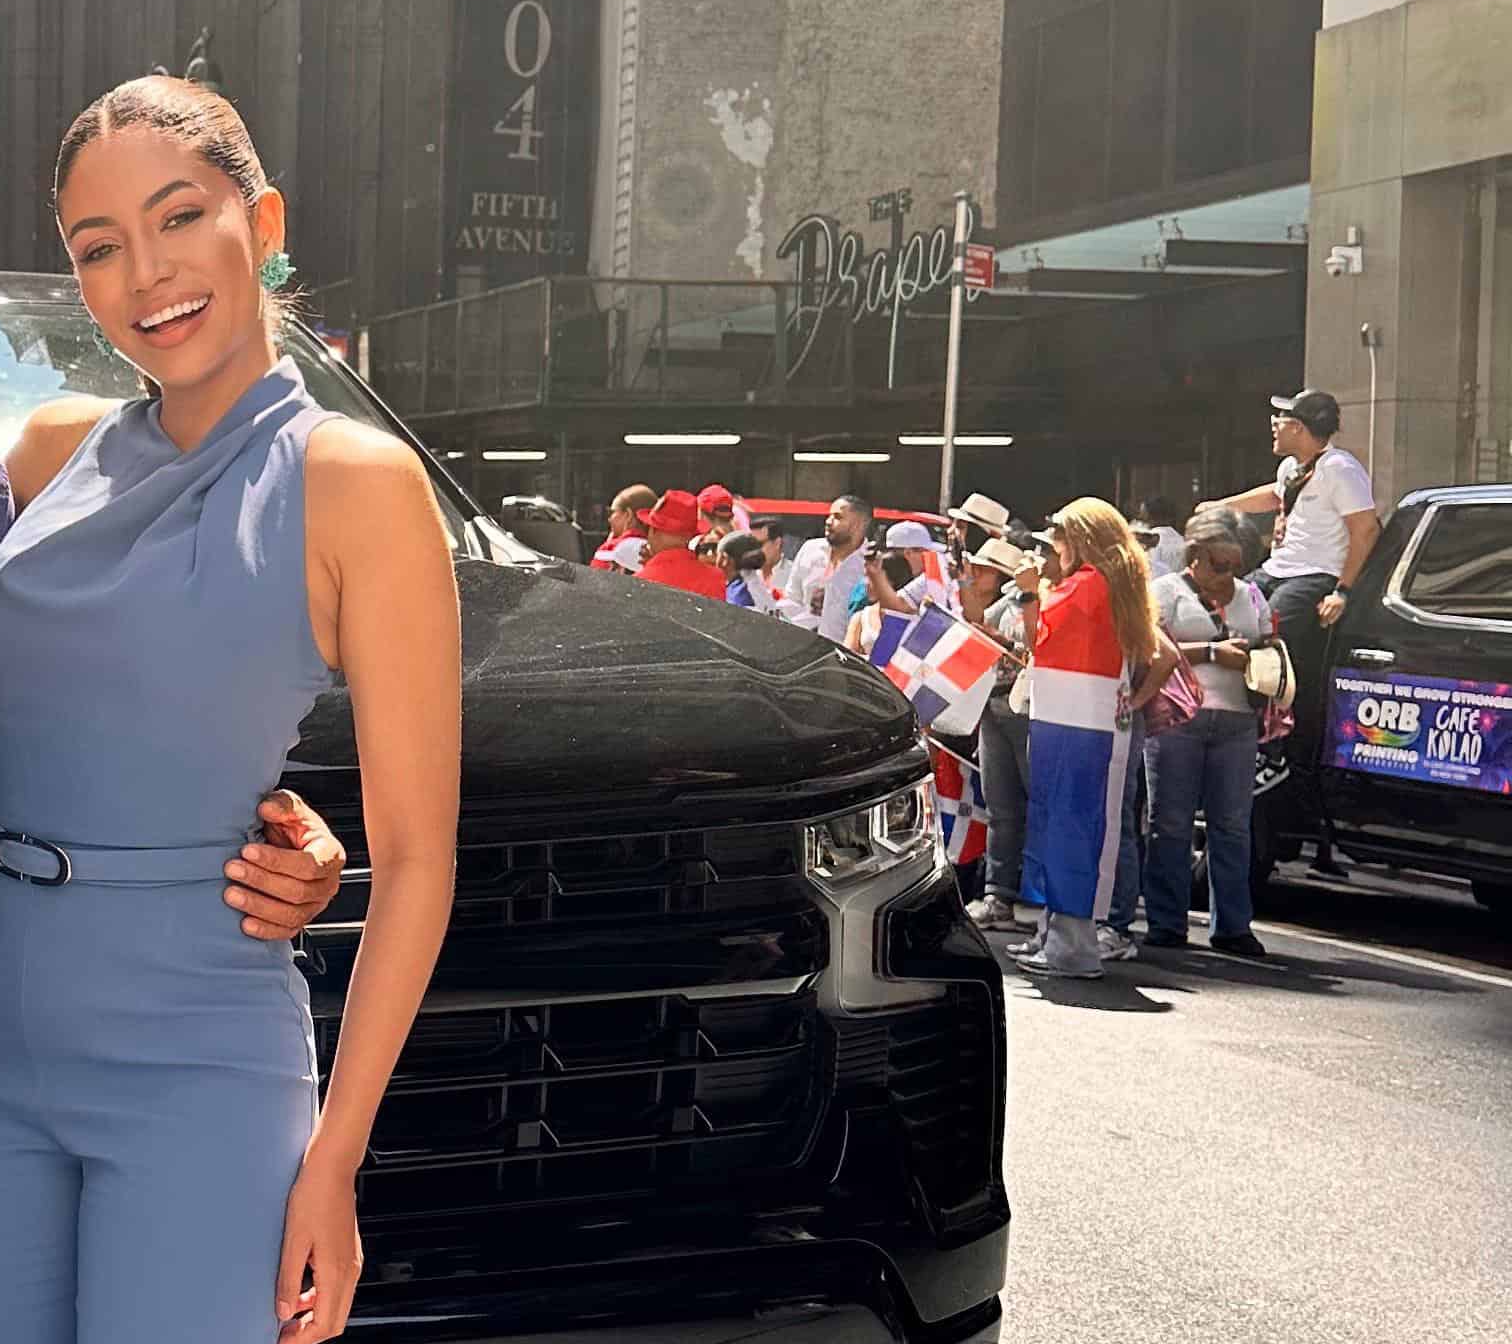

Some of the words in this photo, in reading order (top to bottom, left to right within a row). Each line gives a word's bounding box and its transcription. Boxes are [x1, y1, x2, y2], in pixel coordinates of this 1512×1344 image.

[471, 192, 559, 221] FIFTH
[455, 226, 575, 254] AVENUE
[1336, 678, 1393, 695] TOGETHER
[1394, 685, 1412, 697] WE
[1414, 687, 1450, 702] GROW
[1452, 691, 1512, 709] STRONGE
[1357, 698, 1420, 732] ORB
[1354, 743, 1419, 763] PRINTING
